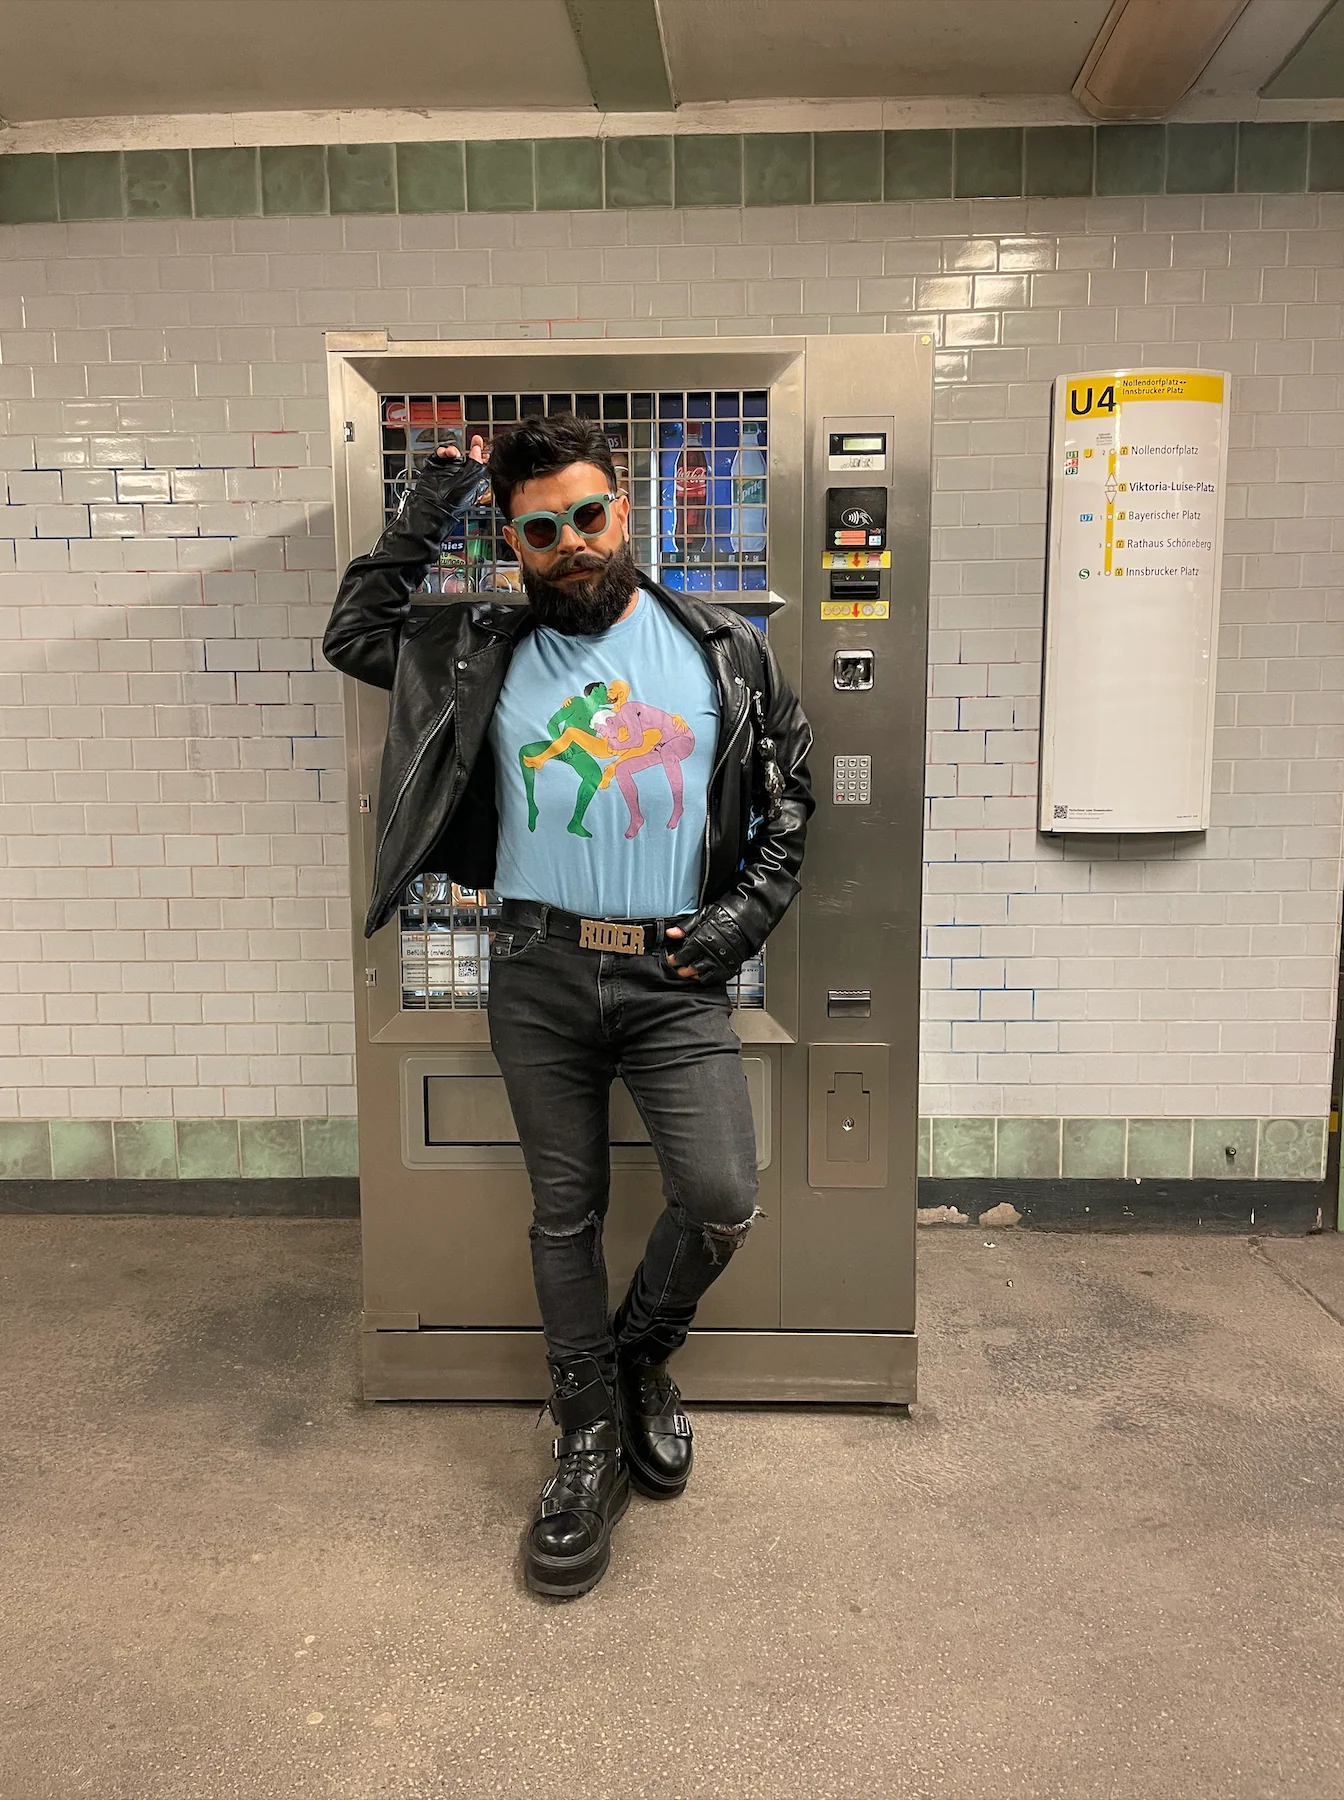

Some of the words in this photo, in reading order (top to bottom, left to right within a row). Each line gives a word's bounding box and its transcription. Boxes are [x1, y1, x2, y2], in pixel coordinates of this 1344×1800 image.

[1122, 378, 1179, 387] Nollendorfplatz
[1122, 387, 1165, 395] Innsbrucker
[1166, 386, 1184, 394] Platz
[1071, 385, 1117, 415] U4
[1066, 451, 1078, 459] U1
[1131, 445, 1199, 456] Nollendorfplatz
[1129, 481, 1215, 493] Viktoria-Luise-Platz
[1080, 514, 1093, 522] U7
[1128, 510, 1179, 522] Bayerischer
[1182, 510, 1201, 520] Platz
[1127, 539, 1164, 549] Rathaus
[1166, 538, 1212, 551] Schöneberg
[1126, 566, 1178, 577] Innsbrucker
[1180, 566, 1200, 576] Platz
[579, 918, 646, 956] RIDER
